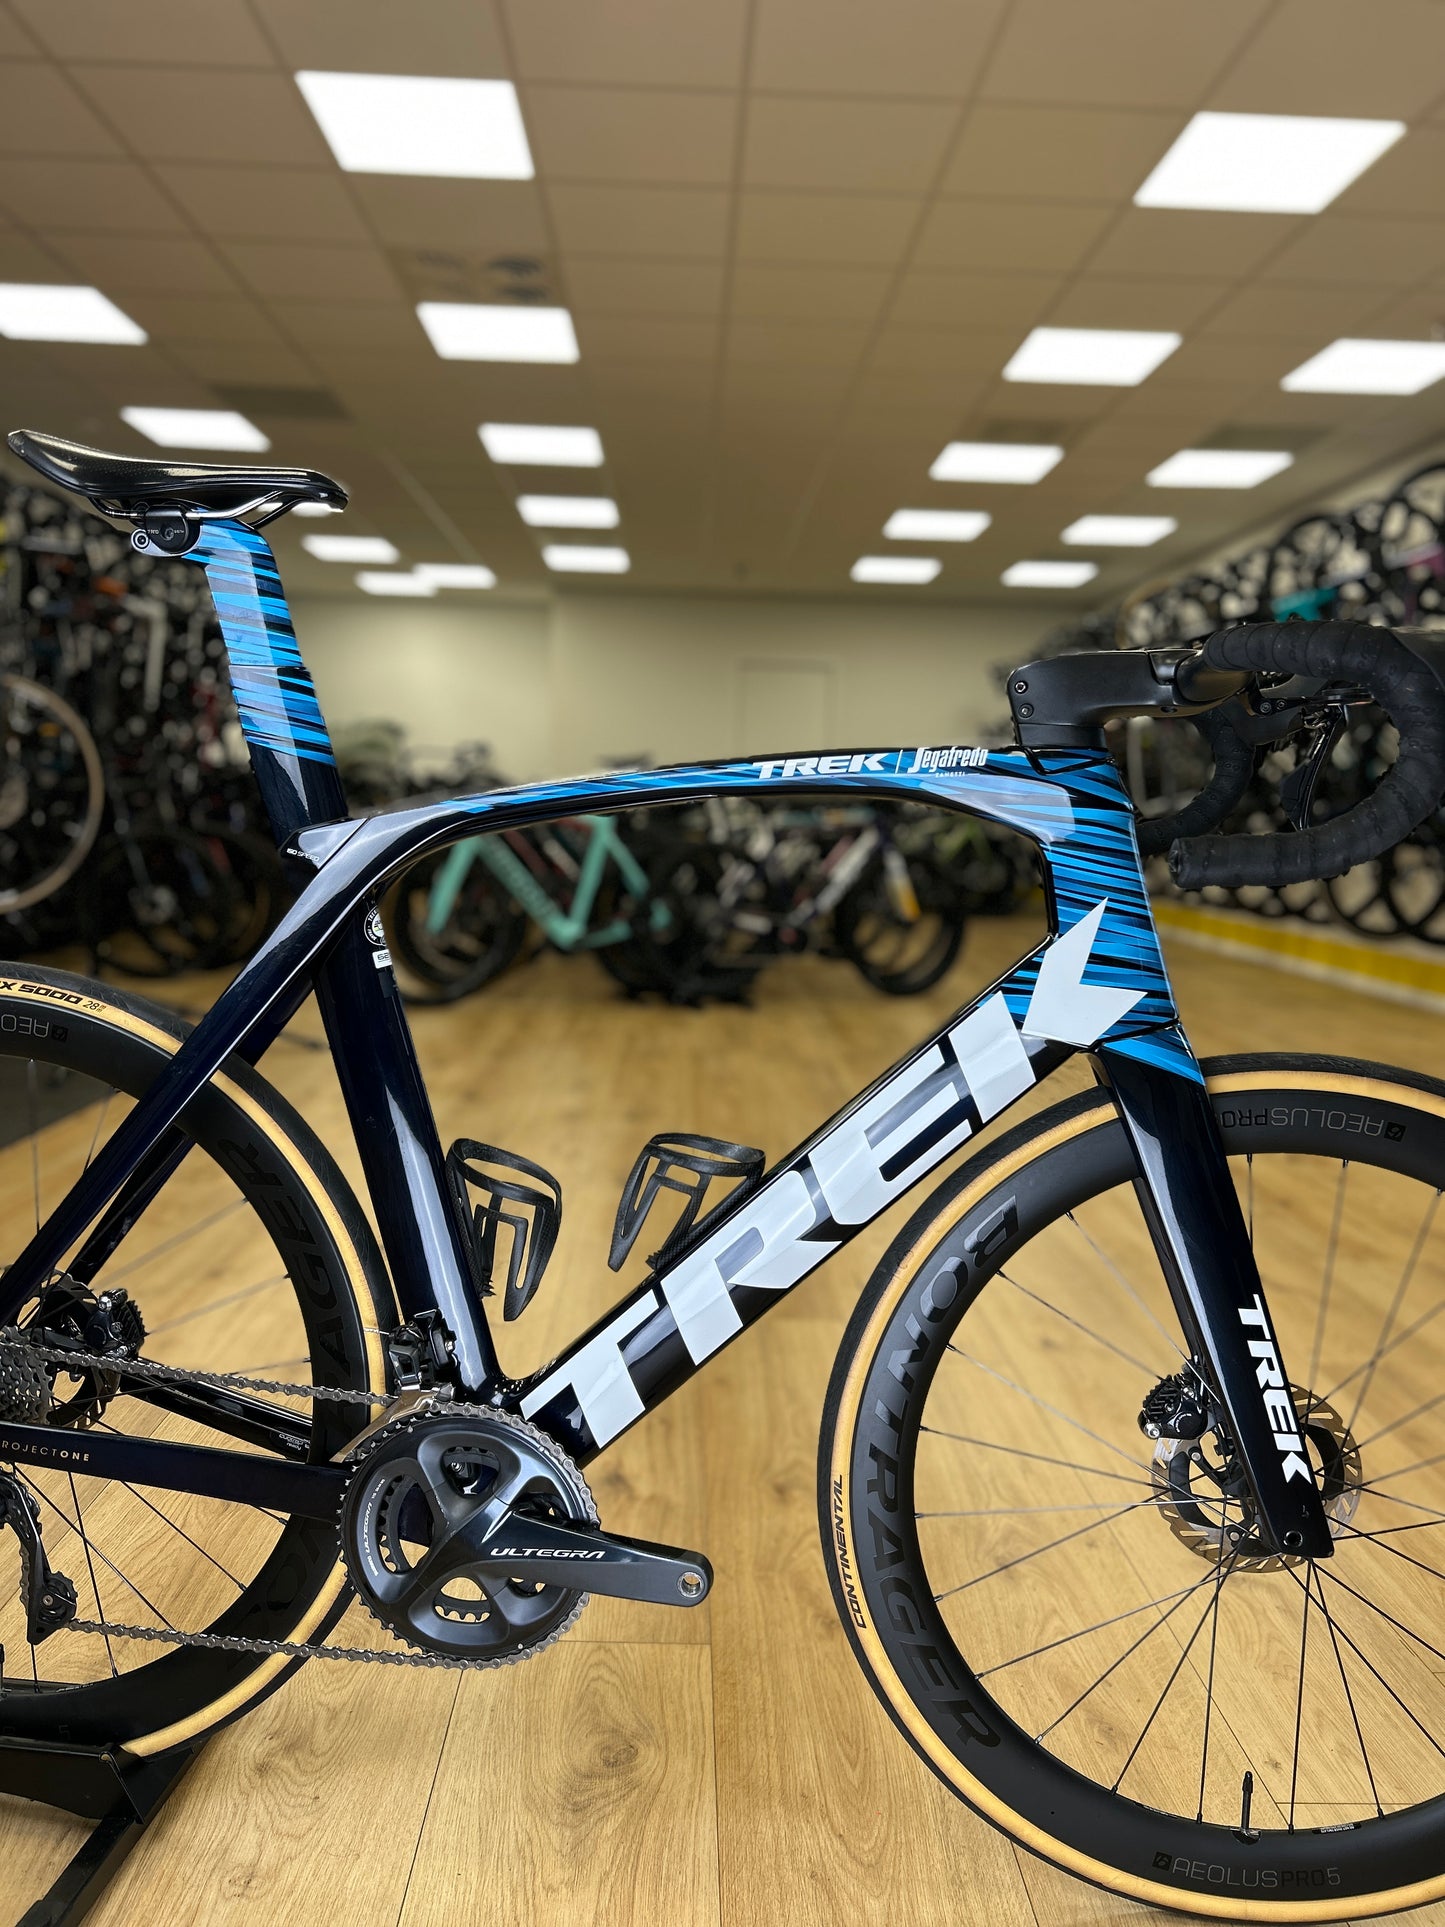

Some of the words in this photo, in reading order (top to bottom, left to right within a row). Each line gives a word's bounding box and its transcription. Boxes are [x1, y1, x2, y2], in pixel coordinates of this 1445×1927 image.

[752, 753, 889, 780] TREK
[909, 746, 988, 773] Segafredo
[18, 984, 83, 1005] 5000
[1, 1013, 50, 1038] AEO
[1219, 1107, 1384, 1137] AEOLUSPRO
[519, 897, 1148, 1449] TREK
[1238, 1294, 1313, 1485] TREK
[1, 1440, 90, 1462] ROJECTONE
[866, 1194, 1020, 1749] BONTRAGER
[363, 1502, 373, 1554] ULTEGRA
[490, 1547, 606, 1560] ULTEGRA
[833, 1474, 867, 1629] CONTINENTAL
